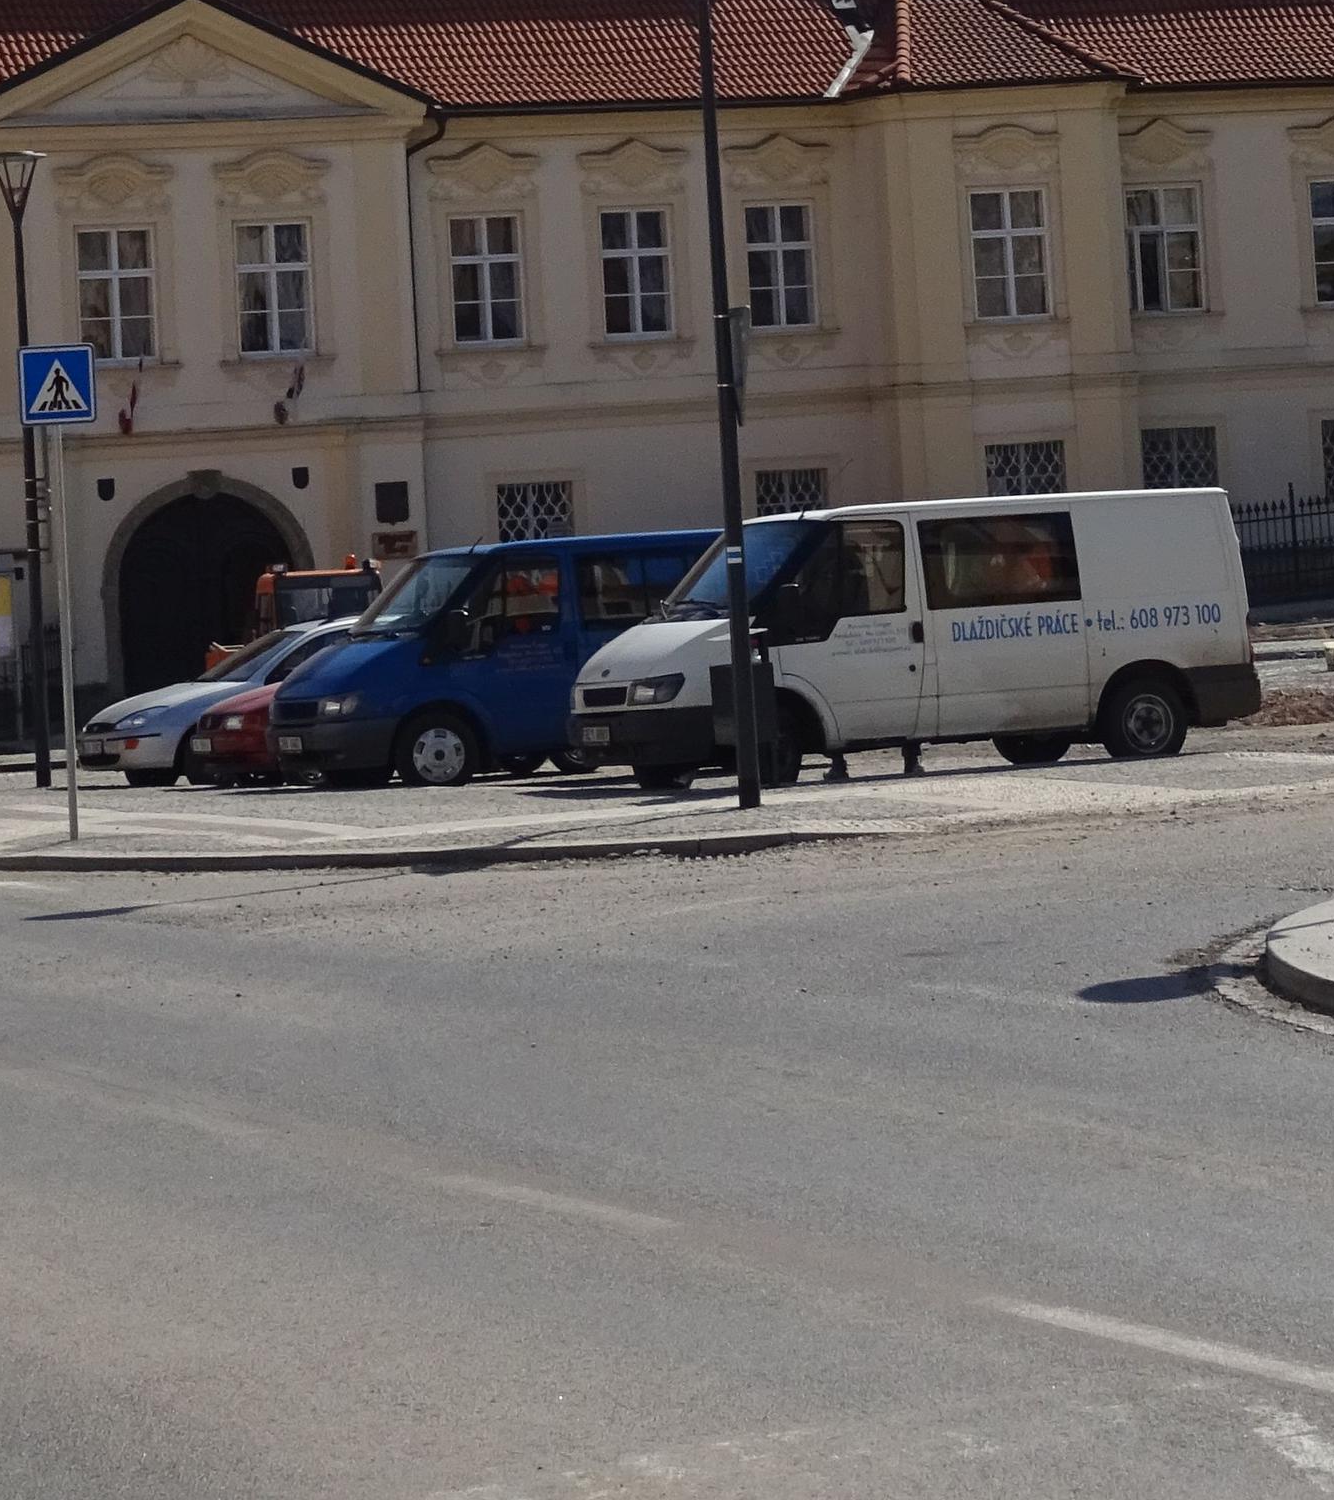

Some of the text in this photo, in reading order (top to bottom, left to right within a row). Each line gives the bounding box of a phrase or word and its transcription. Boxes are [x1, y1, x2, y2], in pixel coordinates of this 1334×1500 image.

[951, 603, 1221, 642] DLAŽDIČSKÉ PRÁCE tel.: 608 973 100
